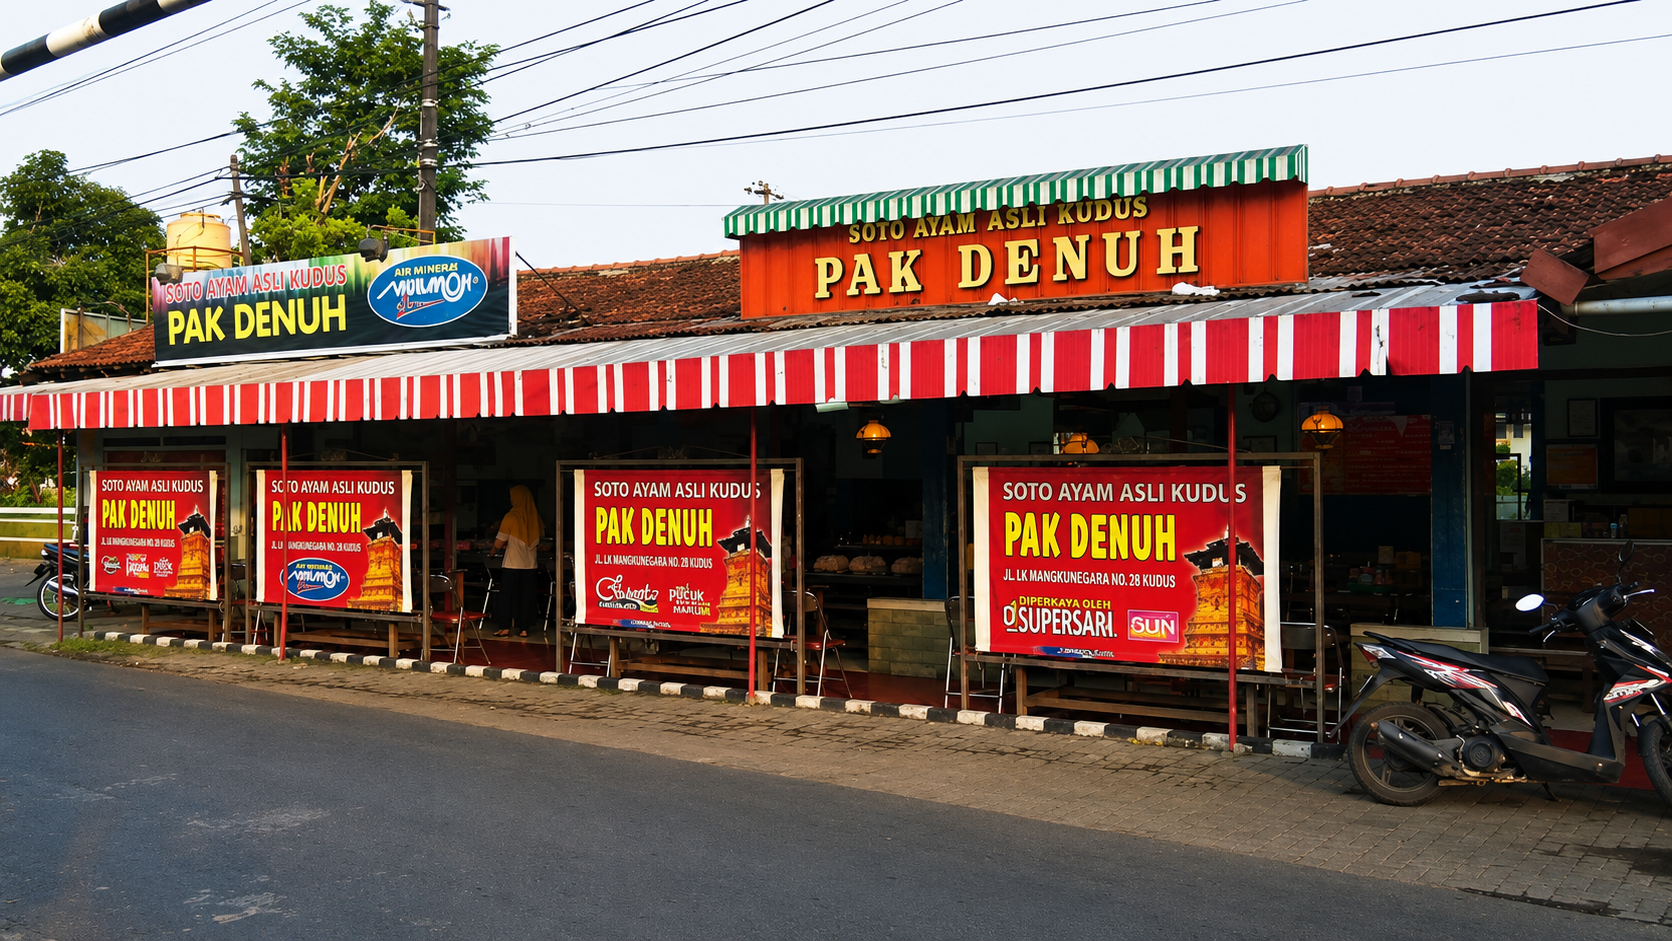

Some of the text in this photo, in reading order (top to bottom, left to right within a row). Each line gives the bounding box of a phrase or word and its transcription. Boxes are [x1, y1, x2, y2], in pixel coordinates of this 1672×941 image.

[849, 197, 1148, 243] SOTO AYAM ASLI KUDUS
[394, 268, 411, 277] AIR
[815, 226, 1199, 299] PAK DENUH
[166, 264, 347, 303] SOTO AYAM ASLI KUDUS
[168, 306, 225, 345] PAK
[234, 294, 346, 339] DENUH
[101, 479, 203, 493] SOTO AYAM ASLI KUDUS
[271, 480, 395, 495] SOTO AYAM ASLI KUDUS
[594, 481, 761, 499] SOTO AYAM ASLI KUDUS
[1003, 482, 1247, 503] SOTO AYAM ASLI KUDUS
[102, 499, 175, 530] PAK DENUH
[272, 501, 361, 533] PAK DENUH
[595, 506, 713, 547] PAK DENUH
[1004, 511, 1176, 562] PAK DENUH
[604, 554, 612, 564] LK
[690, 557, 713, 570] KUDUS
[1016, 569, 1028, 582] LK
[1029, 569, 1110, 585] MANGKUNEGARA
[1111, 573, 1128, 586] NO.
[1129, 573, 1141, 587] 28
[1142, 574, 1176, 588] KUDUS
[1019, 596, 1111, 610] DIPERKAYA OLEH
[1130, 617, 1175, 636] SUN
